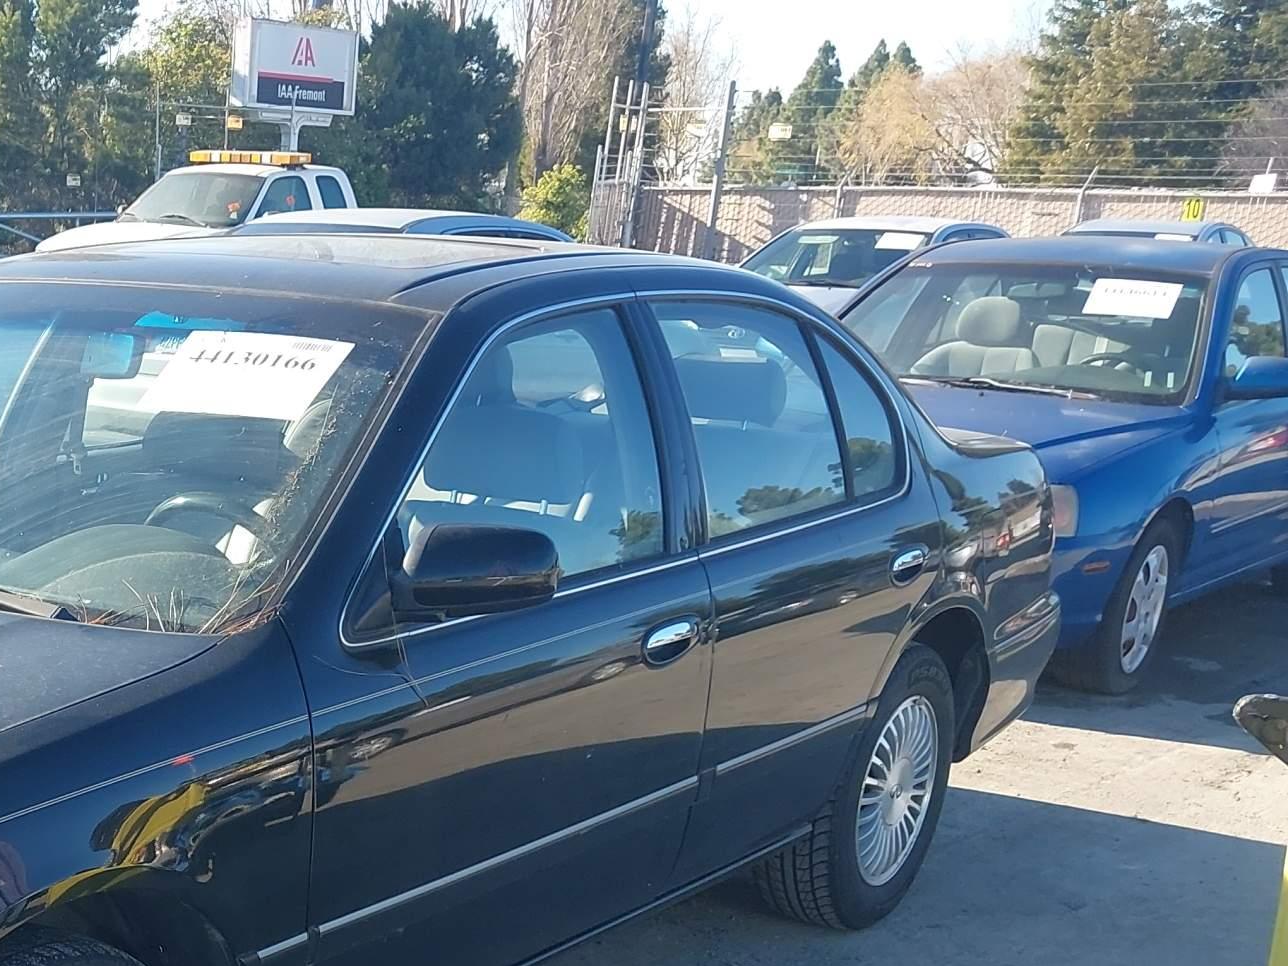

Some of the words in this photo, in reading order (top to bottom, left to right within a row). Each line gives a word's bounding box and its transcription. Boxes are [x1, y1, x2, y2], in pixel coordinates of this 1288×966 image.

[277, 83, 293, 99] IAA
[294, 85, 326, 102] Fremont
[1186, 198, 1201, 219] 10
[189, 349, 316, 371] 44130166
